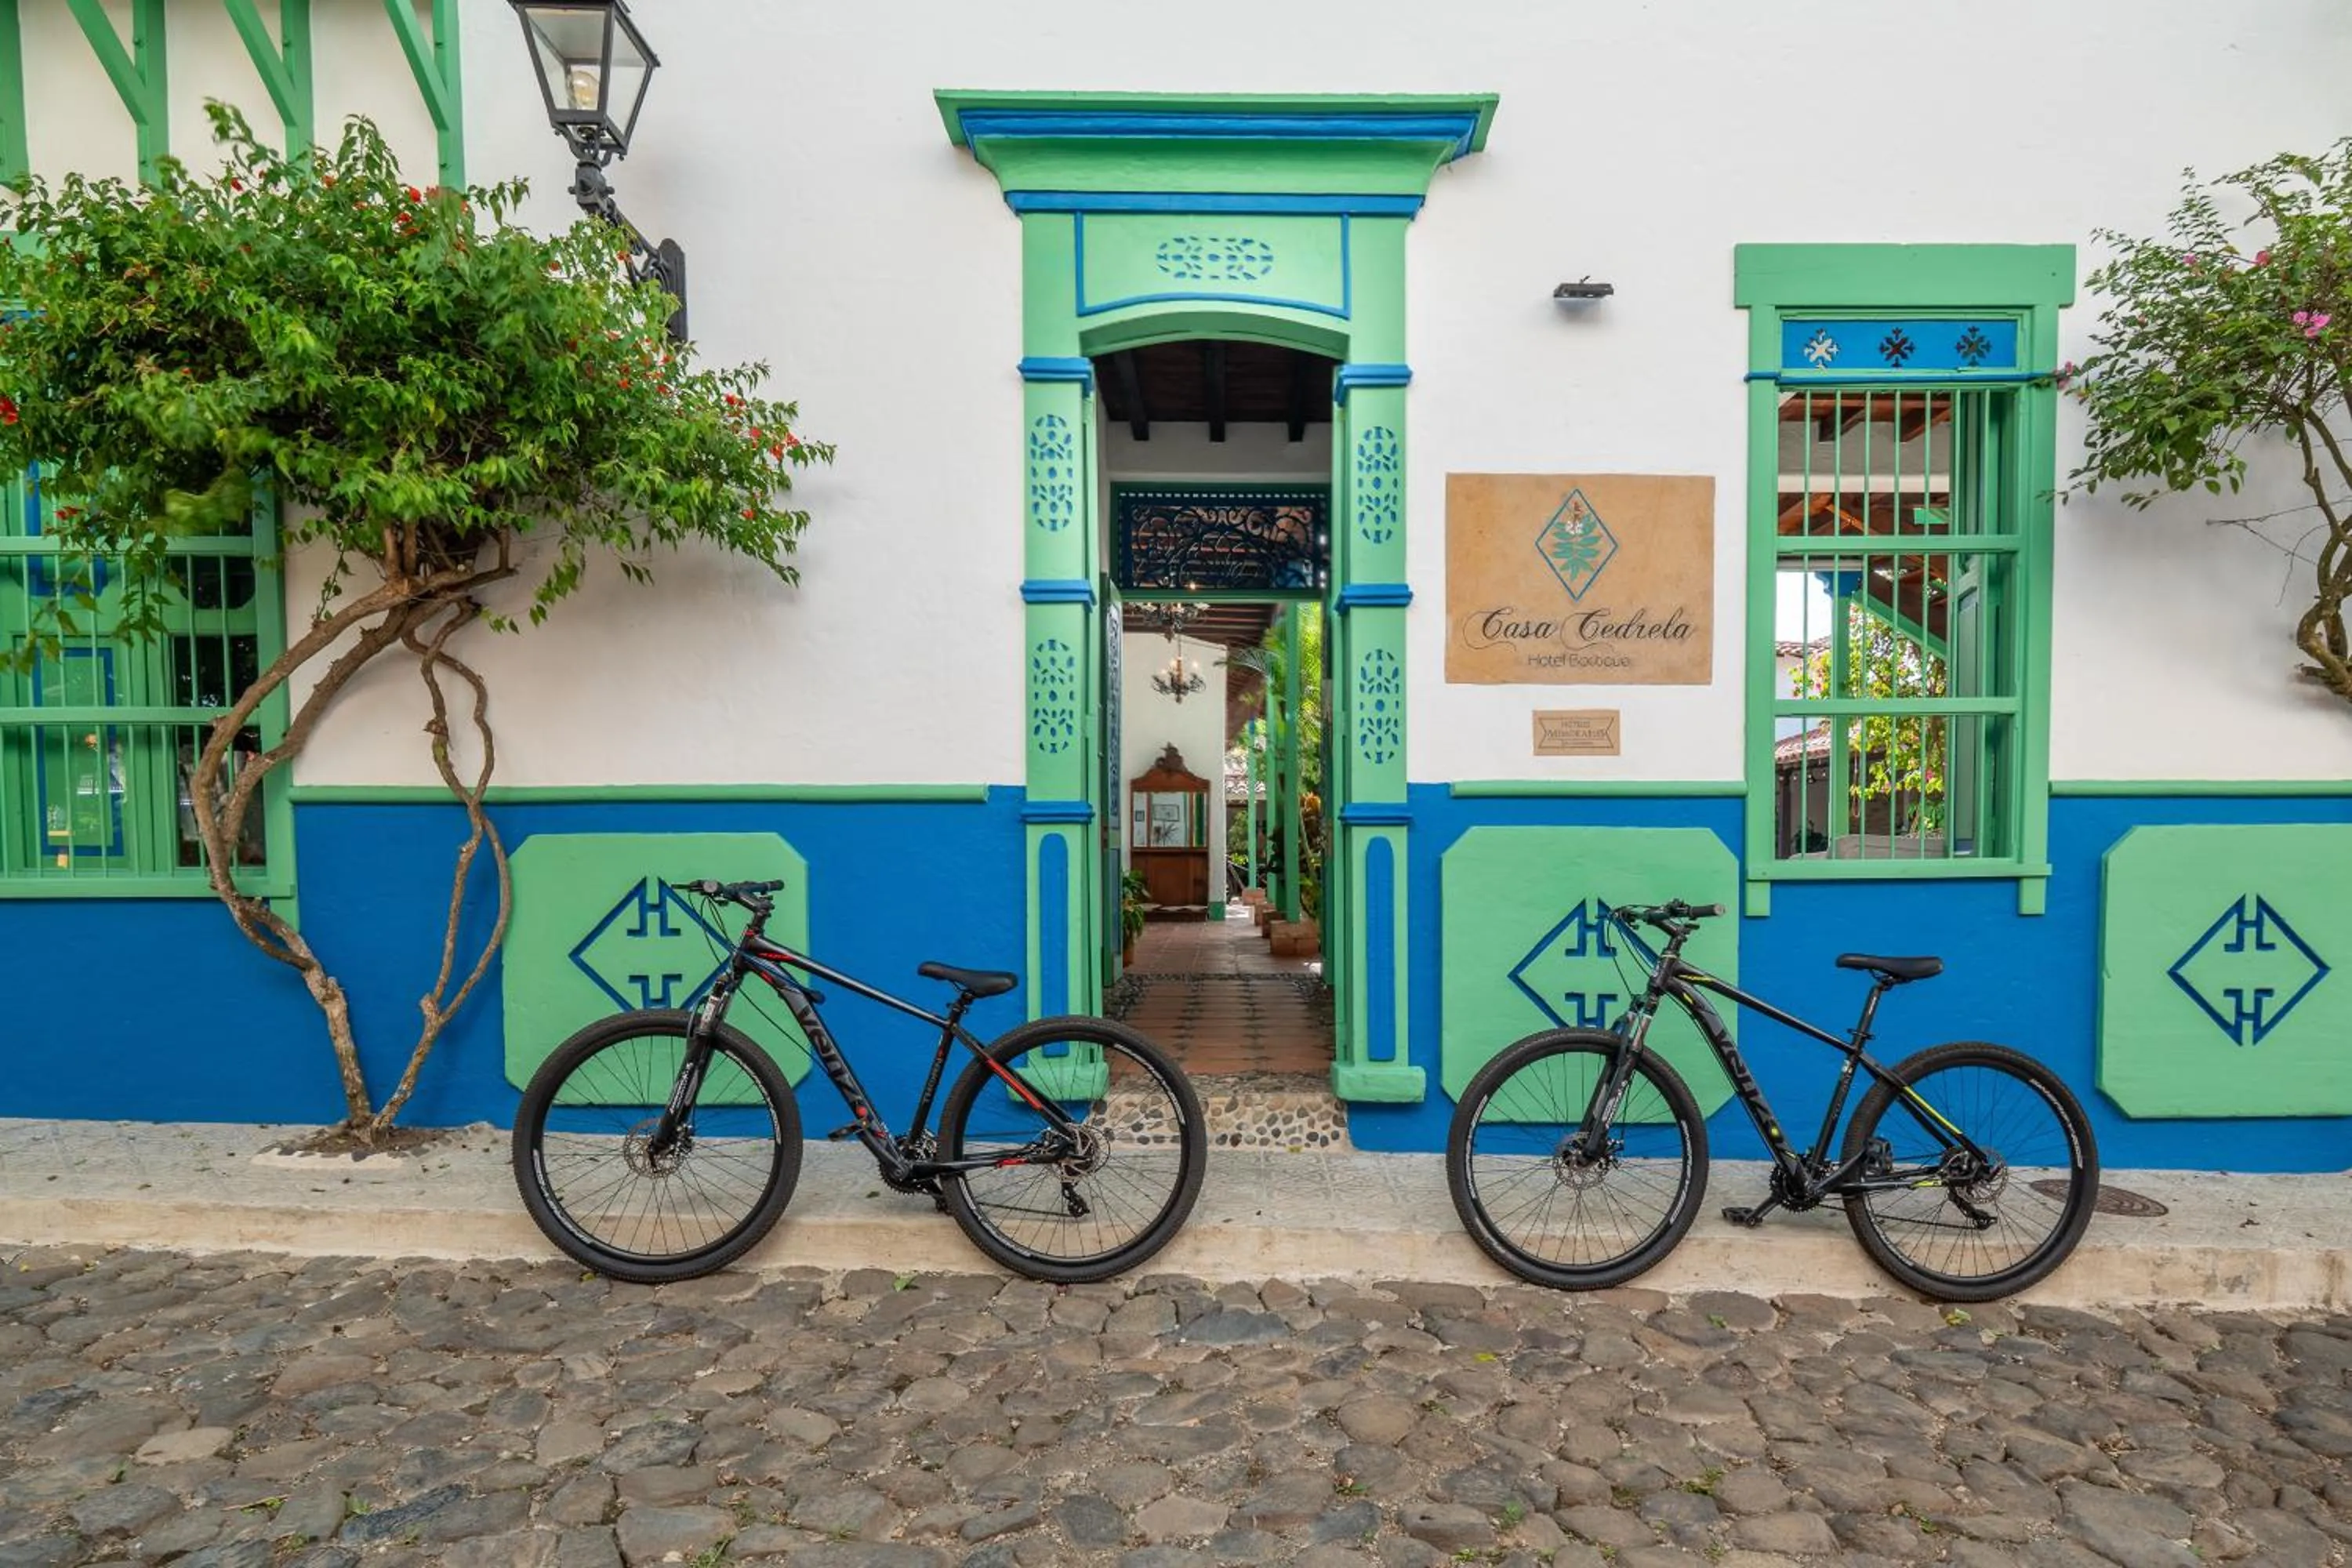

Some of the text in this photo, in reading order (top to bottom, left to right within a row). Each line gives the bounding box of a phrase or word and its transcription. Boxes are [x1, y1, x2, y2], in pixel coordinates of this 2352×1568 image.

[1463, 606, 1698, 652] Casa Cedrela
[1528, 654, 1566, 666] Hotel
